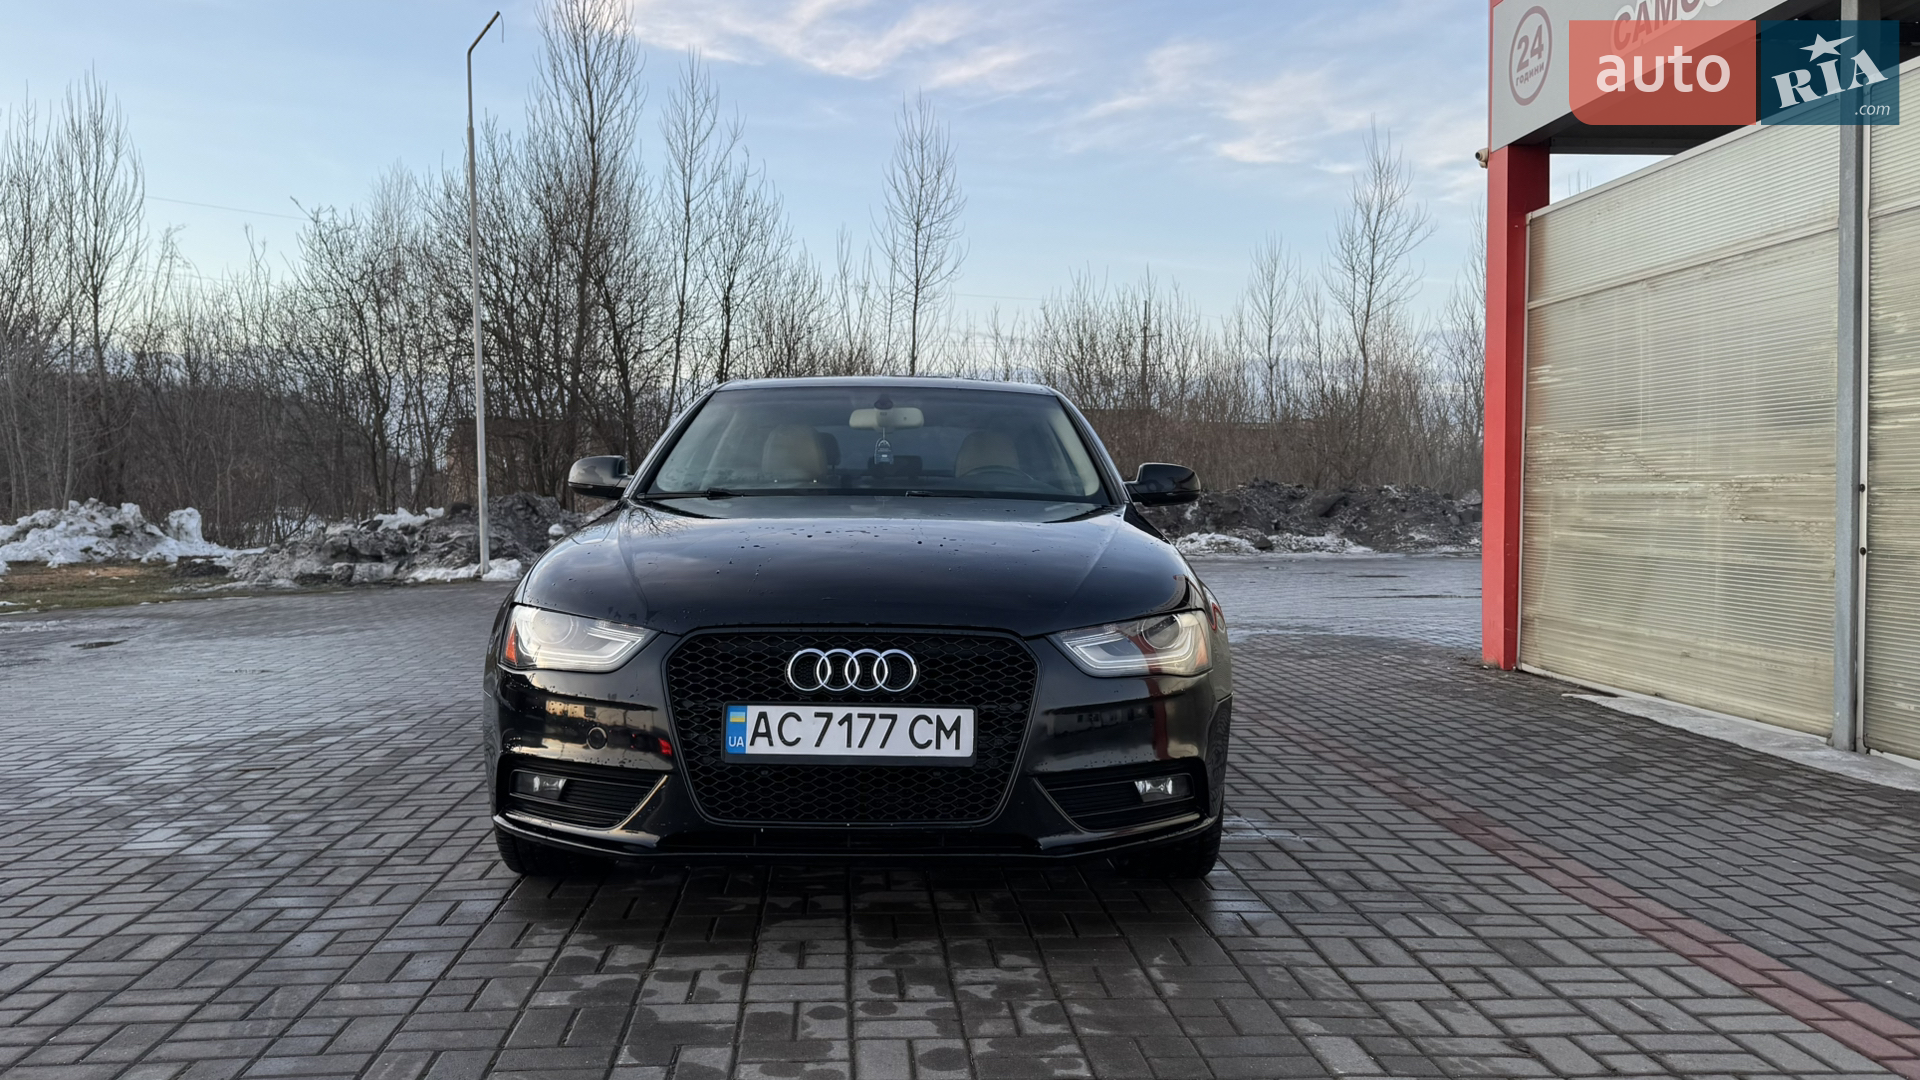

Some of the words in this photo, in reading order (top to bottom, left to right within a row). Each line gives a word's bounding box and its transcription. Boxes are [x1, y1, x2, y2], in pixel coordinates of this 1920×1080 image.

[1516, 24, 1544, 73] 24
[728, 736, 744, 748] UA
[749, 711, 803, 747] AC
[813, 712, 898, 749] 7177
[908, 714, 961, 750] CM
